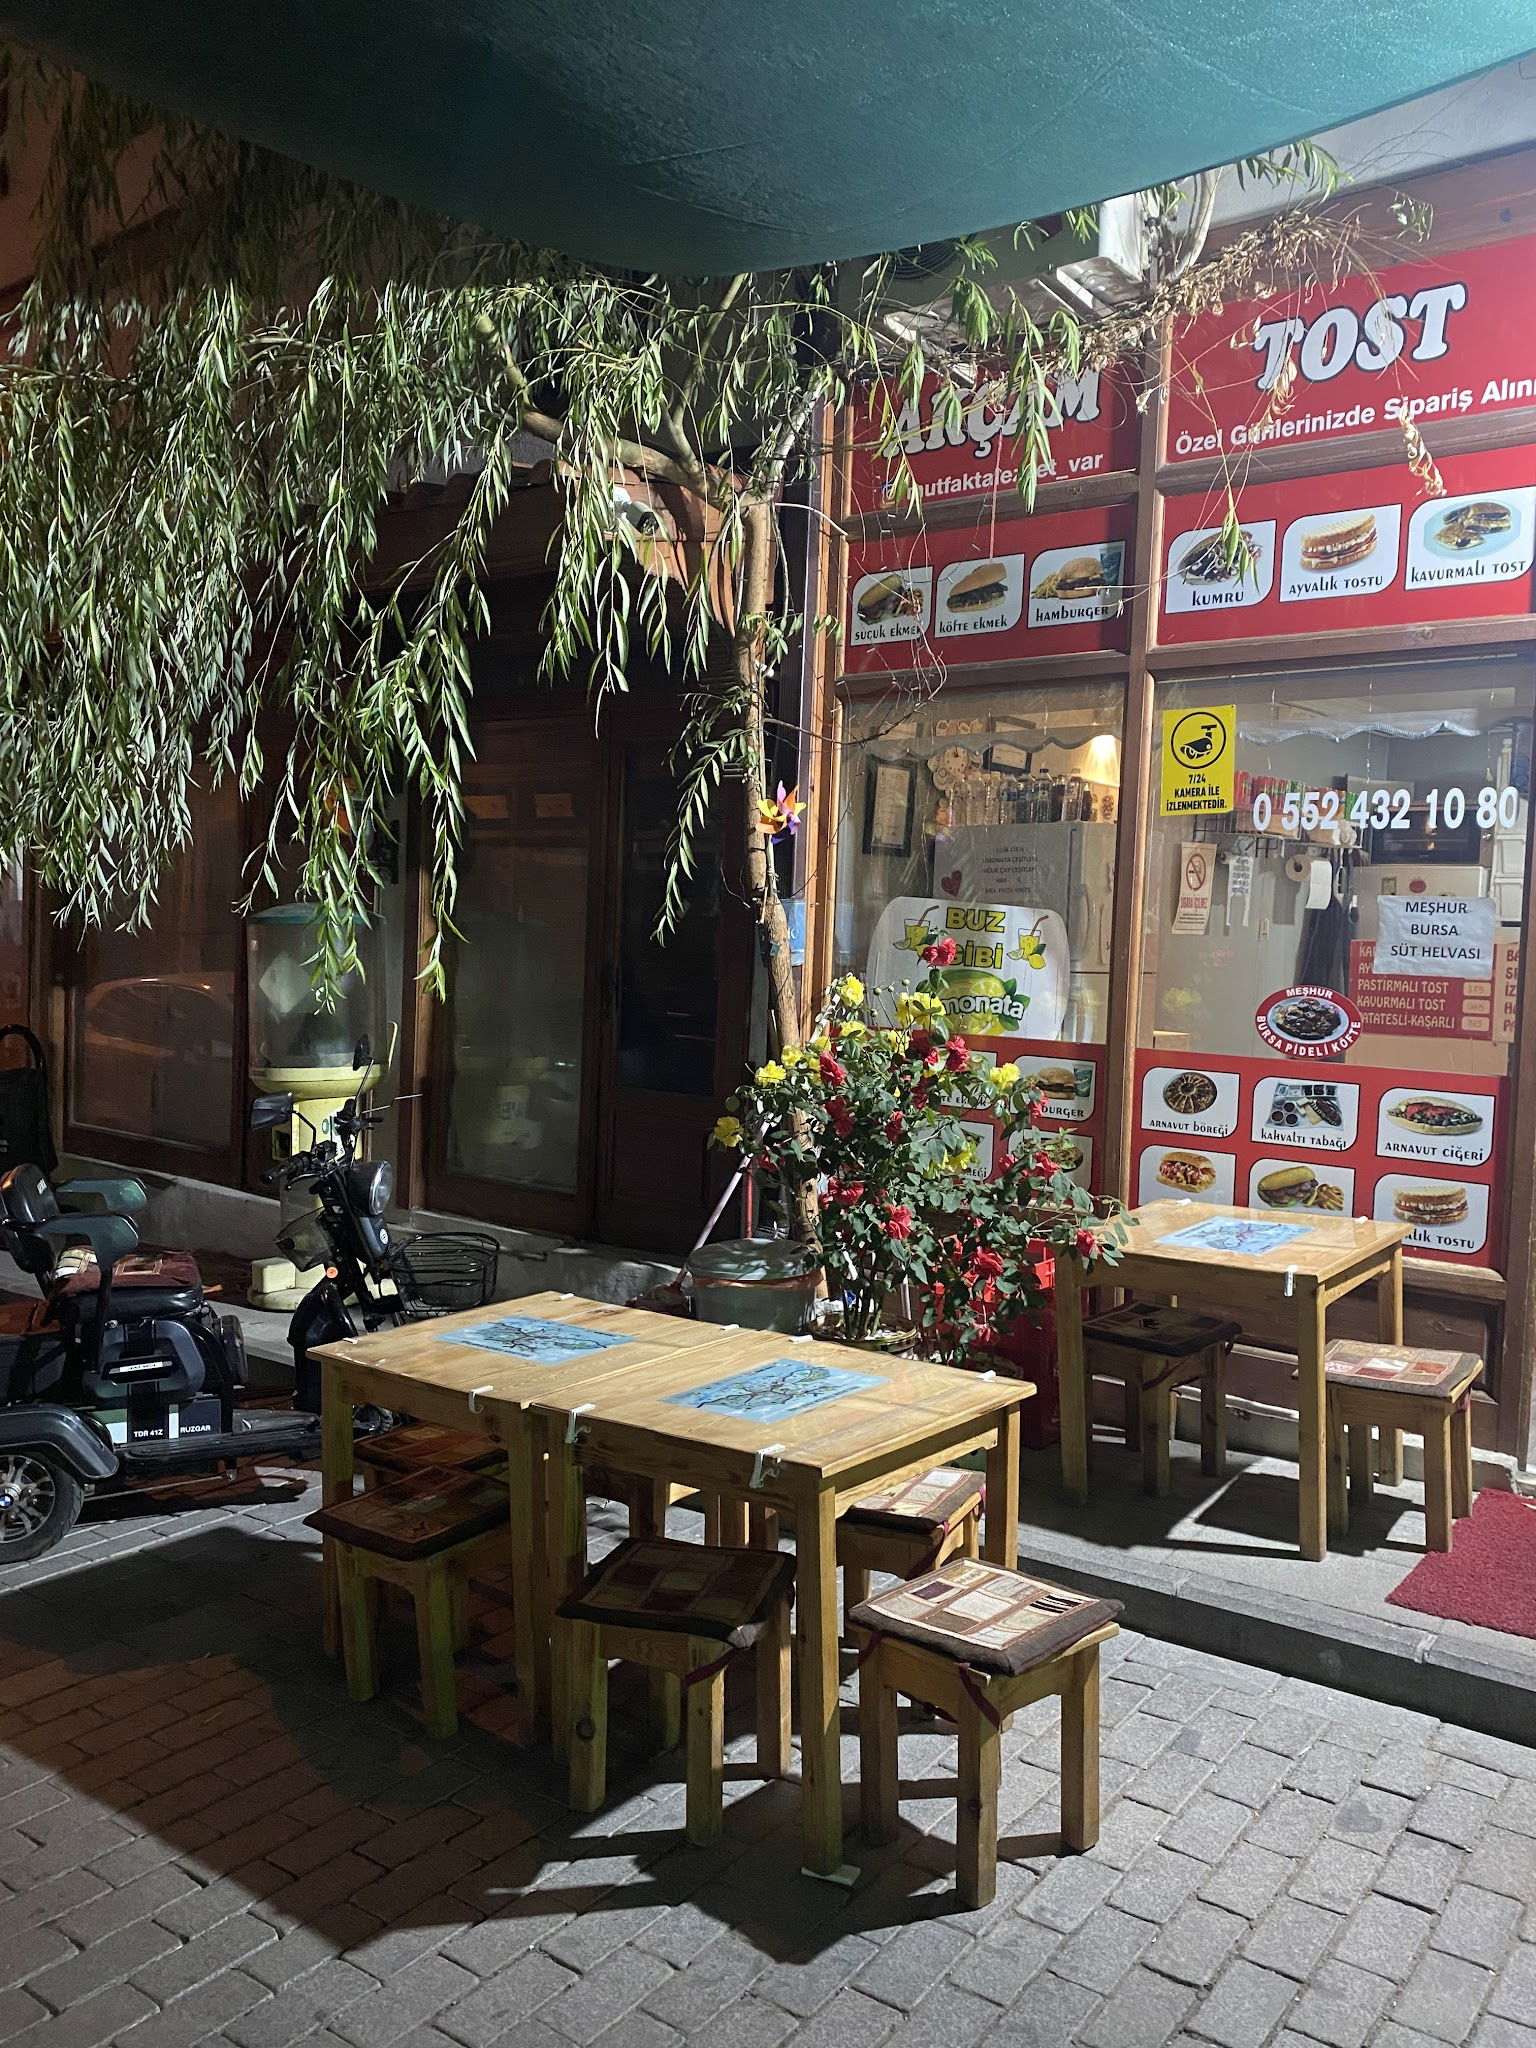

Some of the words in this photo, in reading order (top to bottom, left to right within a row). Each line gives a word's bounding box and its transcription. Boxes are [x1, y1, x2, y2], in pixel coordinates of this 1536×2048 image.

[1254, 281, 1467, 392] TOST
[1176, 430, 1223, 455] Özel
[1231, 403, 1375, 446] Günlerinizde
[1384, 388, 1474, 418] Sipariş
[1189, 774, 1206, 784] 7/24
[1174, 786, 1206, 798] KAMERA
[1208, 784, 1220, 796] İLE
[1252, 793, 1272, 831] 0
[1281, 791, 1340, 830] 552
[1350, 789, 1411, 829] 432
[1426, 788, 1465, 829] 10
[1476, 786, 1519, 829] 80
[1405, 902, 1467, 915] MEŞHUR
[945, 907, 1006, 933] BUZ
[1411, 923, 1459, 936] BURSA
[1390, 942, 1418, 957] SÜT
[1421, 946, 1480, 960] HELVASI
[1286, 987, 1334, 999] MEŞHUR
[1357, 978, 1418, 993] PASTIRMALI
[1421, 981, 1449, 994] TOST
[1356, 995, 1415, 1009] KAVURMALI
[1418, 998, 1446, 1011] TOST
[1257, 1015, 1283, 1050] BURSA
[1285, 1043, 1329, 1057] PİDELİ
[1331, 1021, 1361, 1053] KÖFTE
